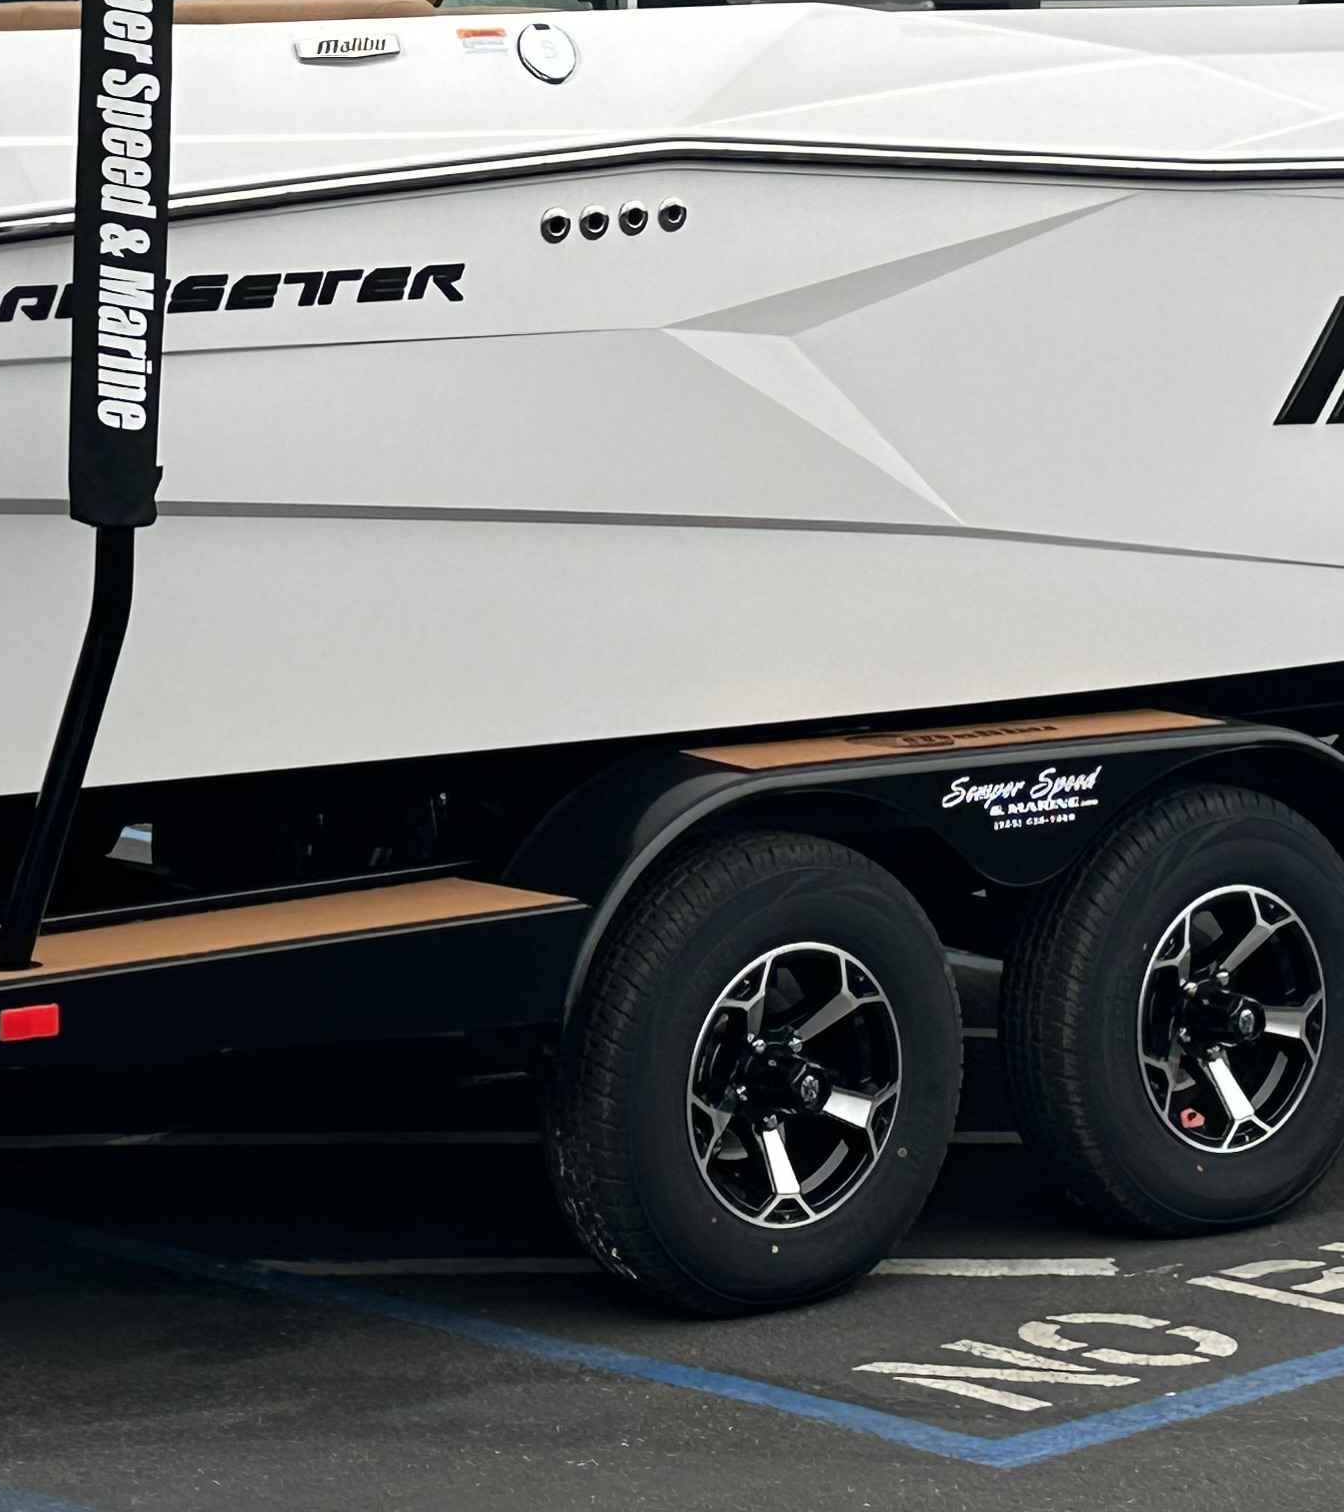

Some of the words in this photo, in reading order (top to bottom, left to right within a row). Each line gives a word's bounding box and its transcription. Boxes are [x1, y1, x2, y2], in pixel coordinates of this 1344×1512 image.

[317, 37, 387, 55] Malibu
[97, 69, 160, 219] Speed
[100, 221, 151, 257] &
[98, 265, 155, 431] Marine
[853, 1313, 1238, 1411] NO
